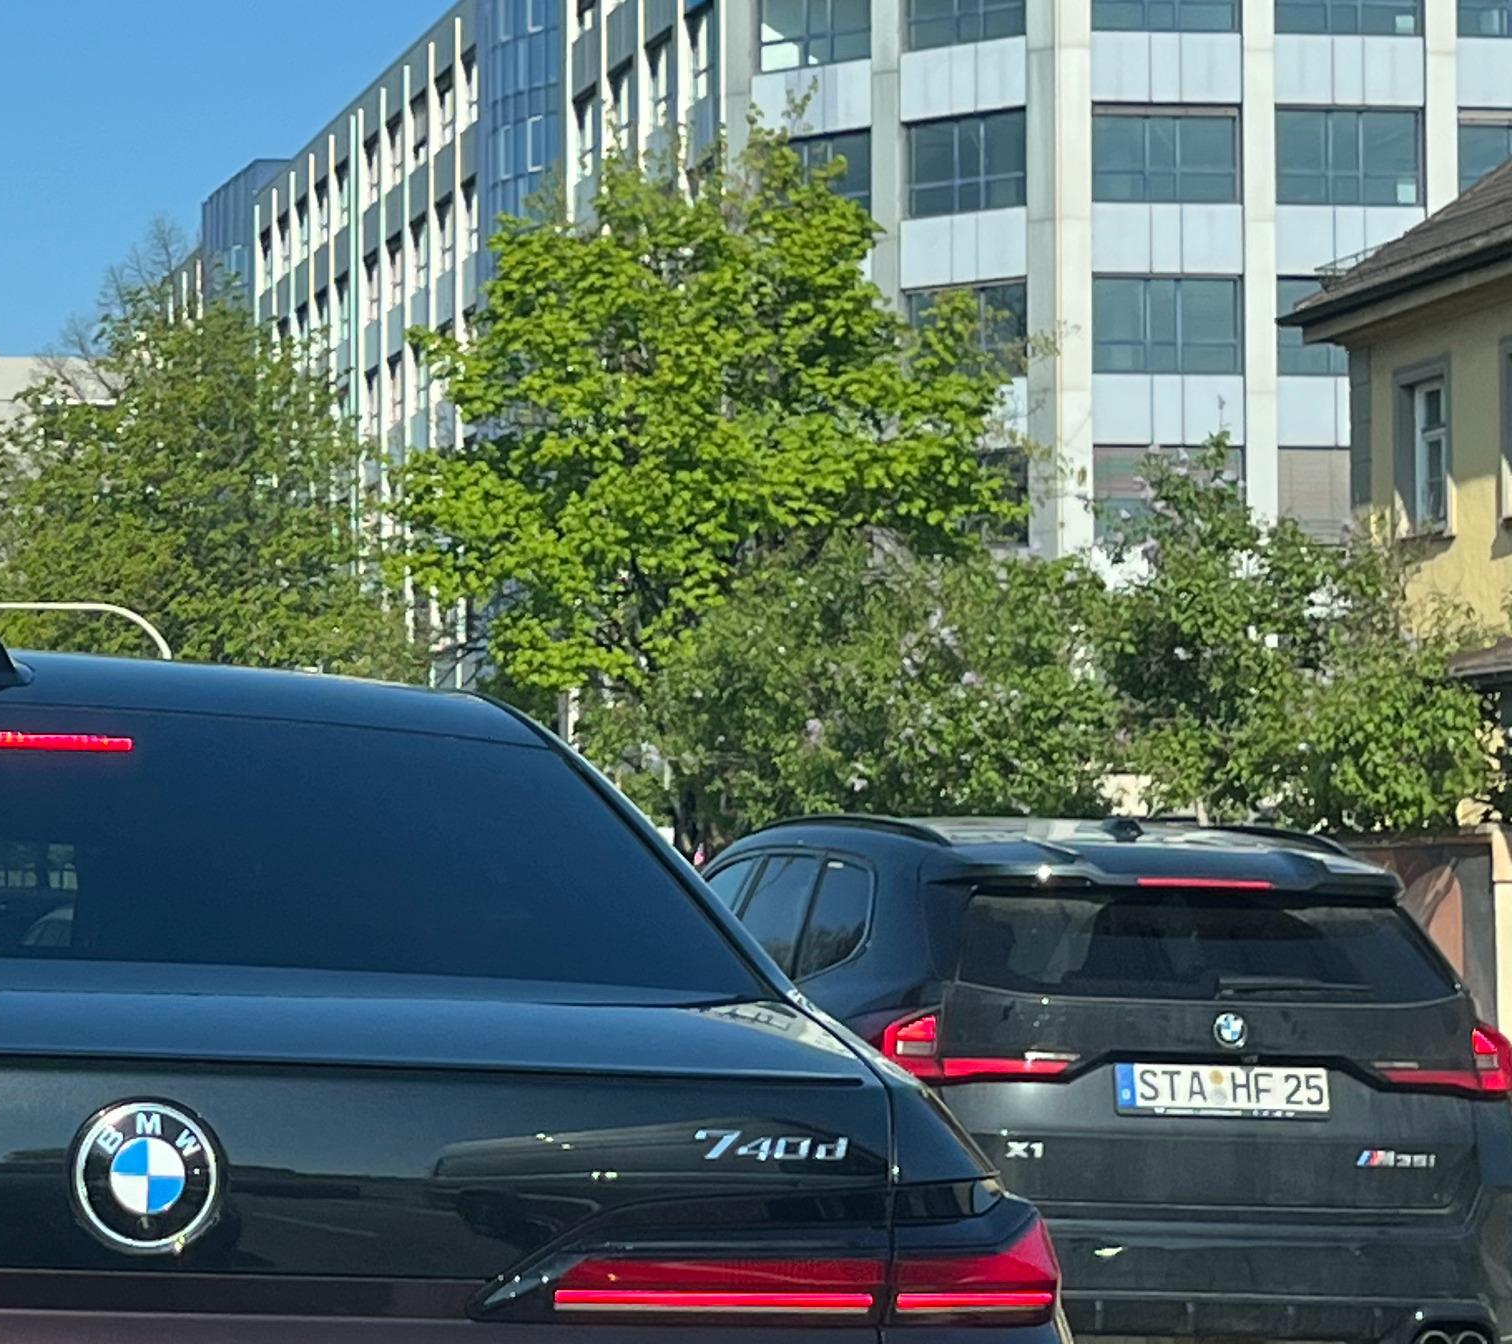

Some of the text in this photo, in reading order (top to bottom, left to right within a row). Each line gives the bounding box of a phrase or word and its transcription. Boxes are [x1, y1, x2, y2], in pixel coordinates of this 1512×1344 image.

[1139, 1069, 1325, 1106] STA HF 25
[96, 1111, 201, 1156] BMW
[695, 1129, 849, 1161] 740d
[1006, 1141, 1044, 1158] X1
